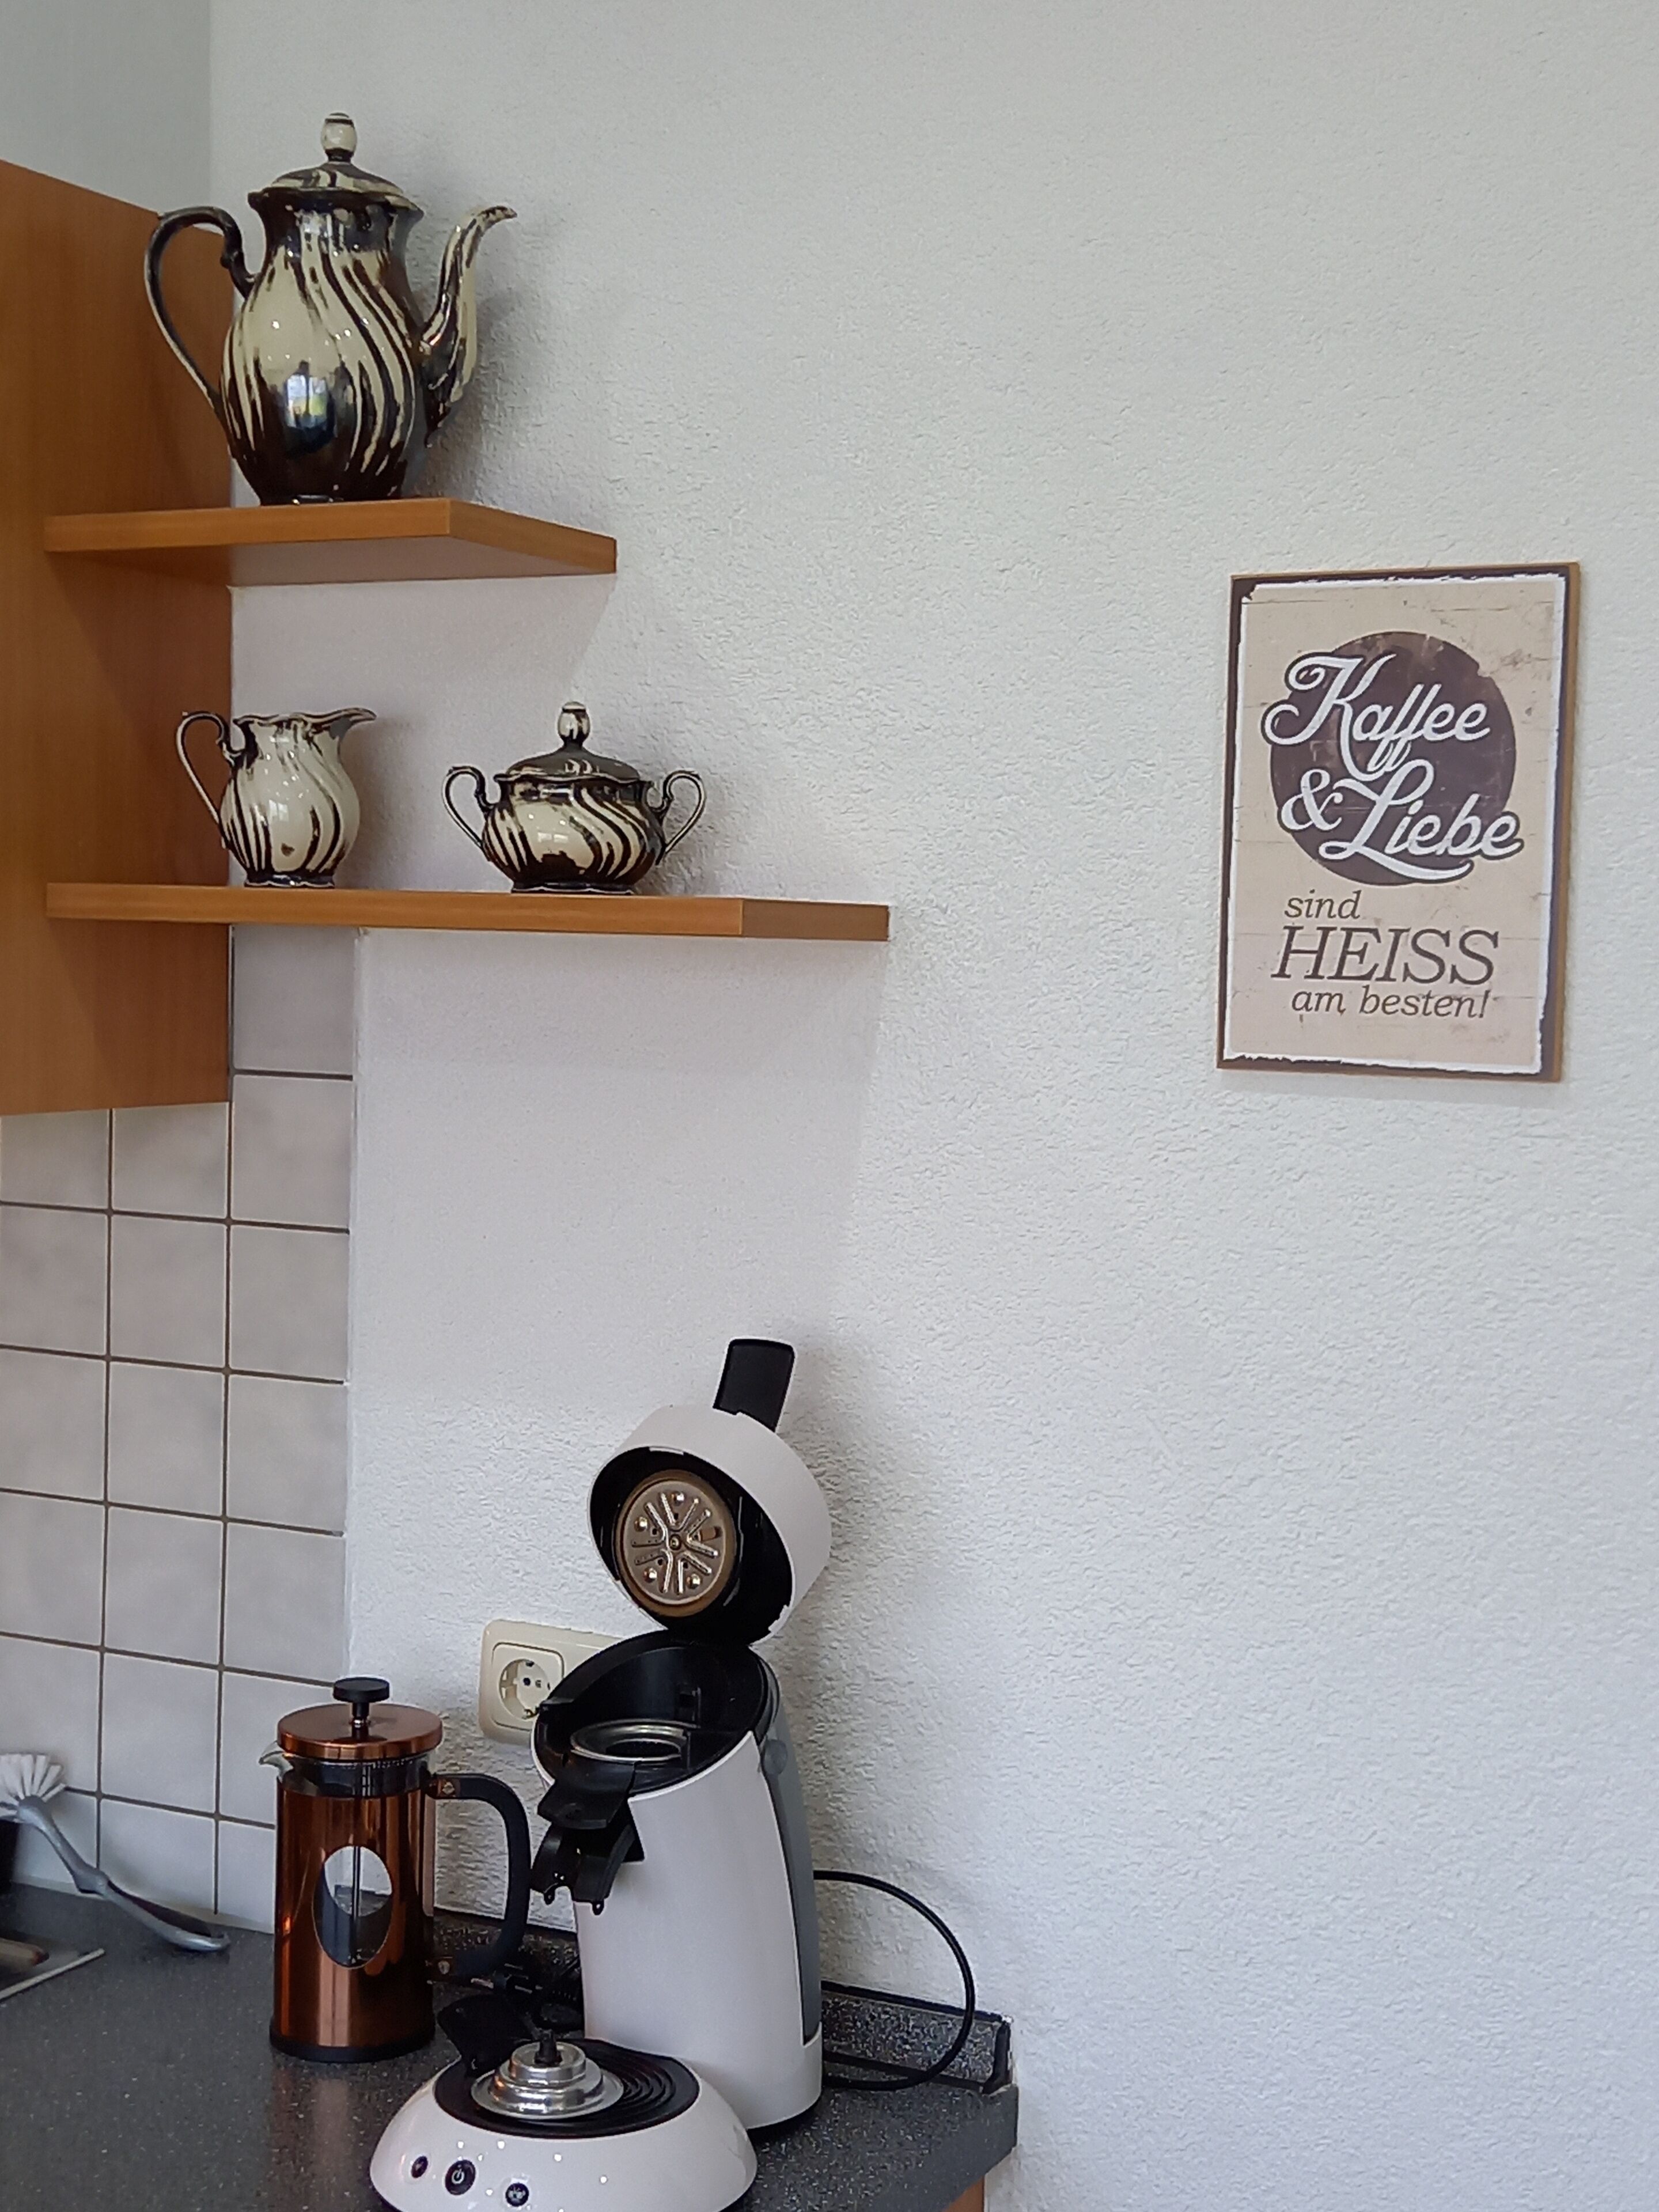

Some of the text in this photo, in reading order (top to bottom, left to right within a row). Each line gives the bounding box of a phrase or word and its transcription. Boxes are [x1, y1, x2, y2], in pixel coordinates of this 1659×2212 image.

[1264, 653, 1491, 782] Kaffee
[1281, 759, 1524, 880] & Liebe
[1284, 889, 1361, 920] sind
[1270, 925, 1500, 986] HEISS
[1291, 985, 1491, 1019] am besten!
